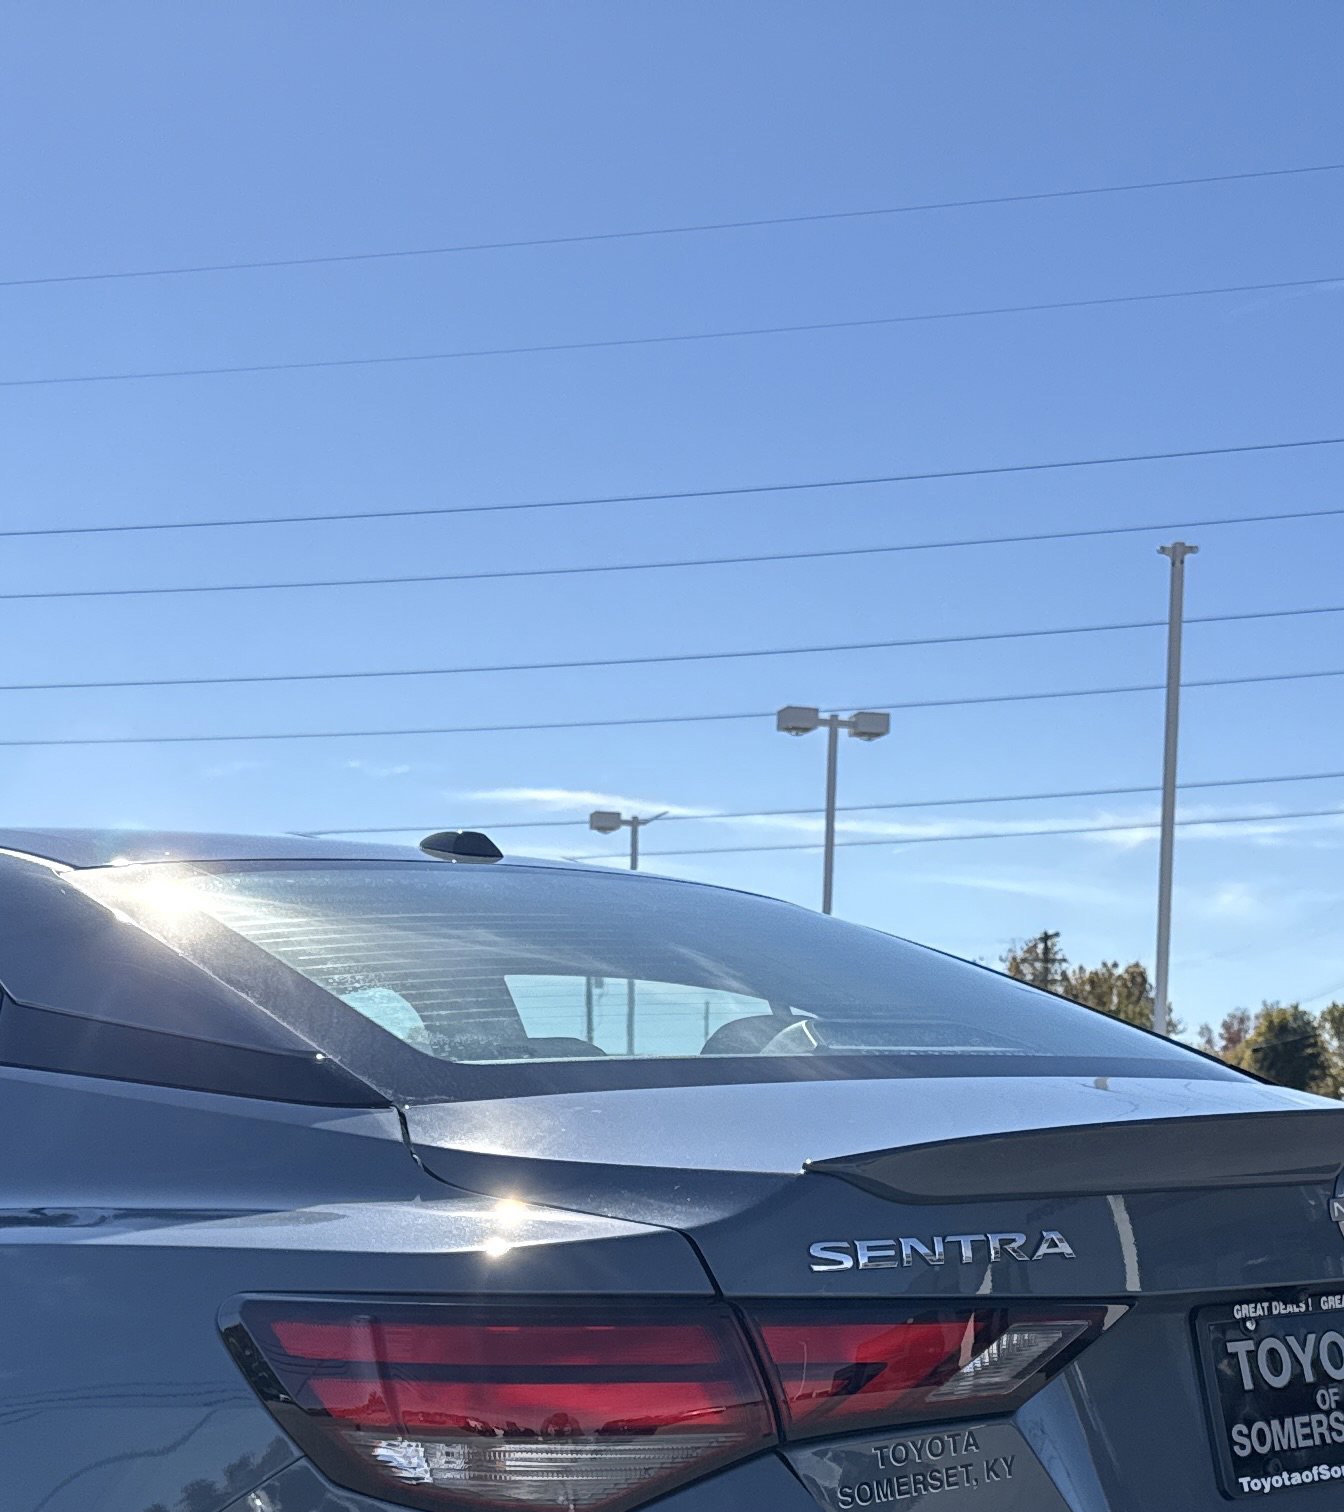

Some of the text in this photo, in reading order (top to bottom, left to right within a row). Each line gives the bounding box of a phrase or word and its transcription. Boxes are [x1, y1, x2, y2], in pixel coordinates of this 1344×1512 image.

[809, 1230, 1076, 1272] SENTRA
[1233, 1302, 1268, 1319] GREAT
[1316, 1388, 1340, 1411] OF
[872, 1430, 981, 1469] TOYOTA
[837, 1454, 1016, 1509] SOMERSET, KY
